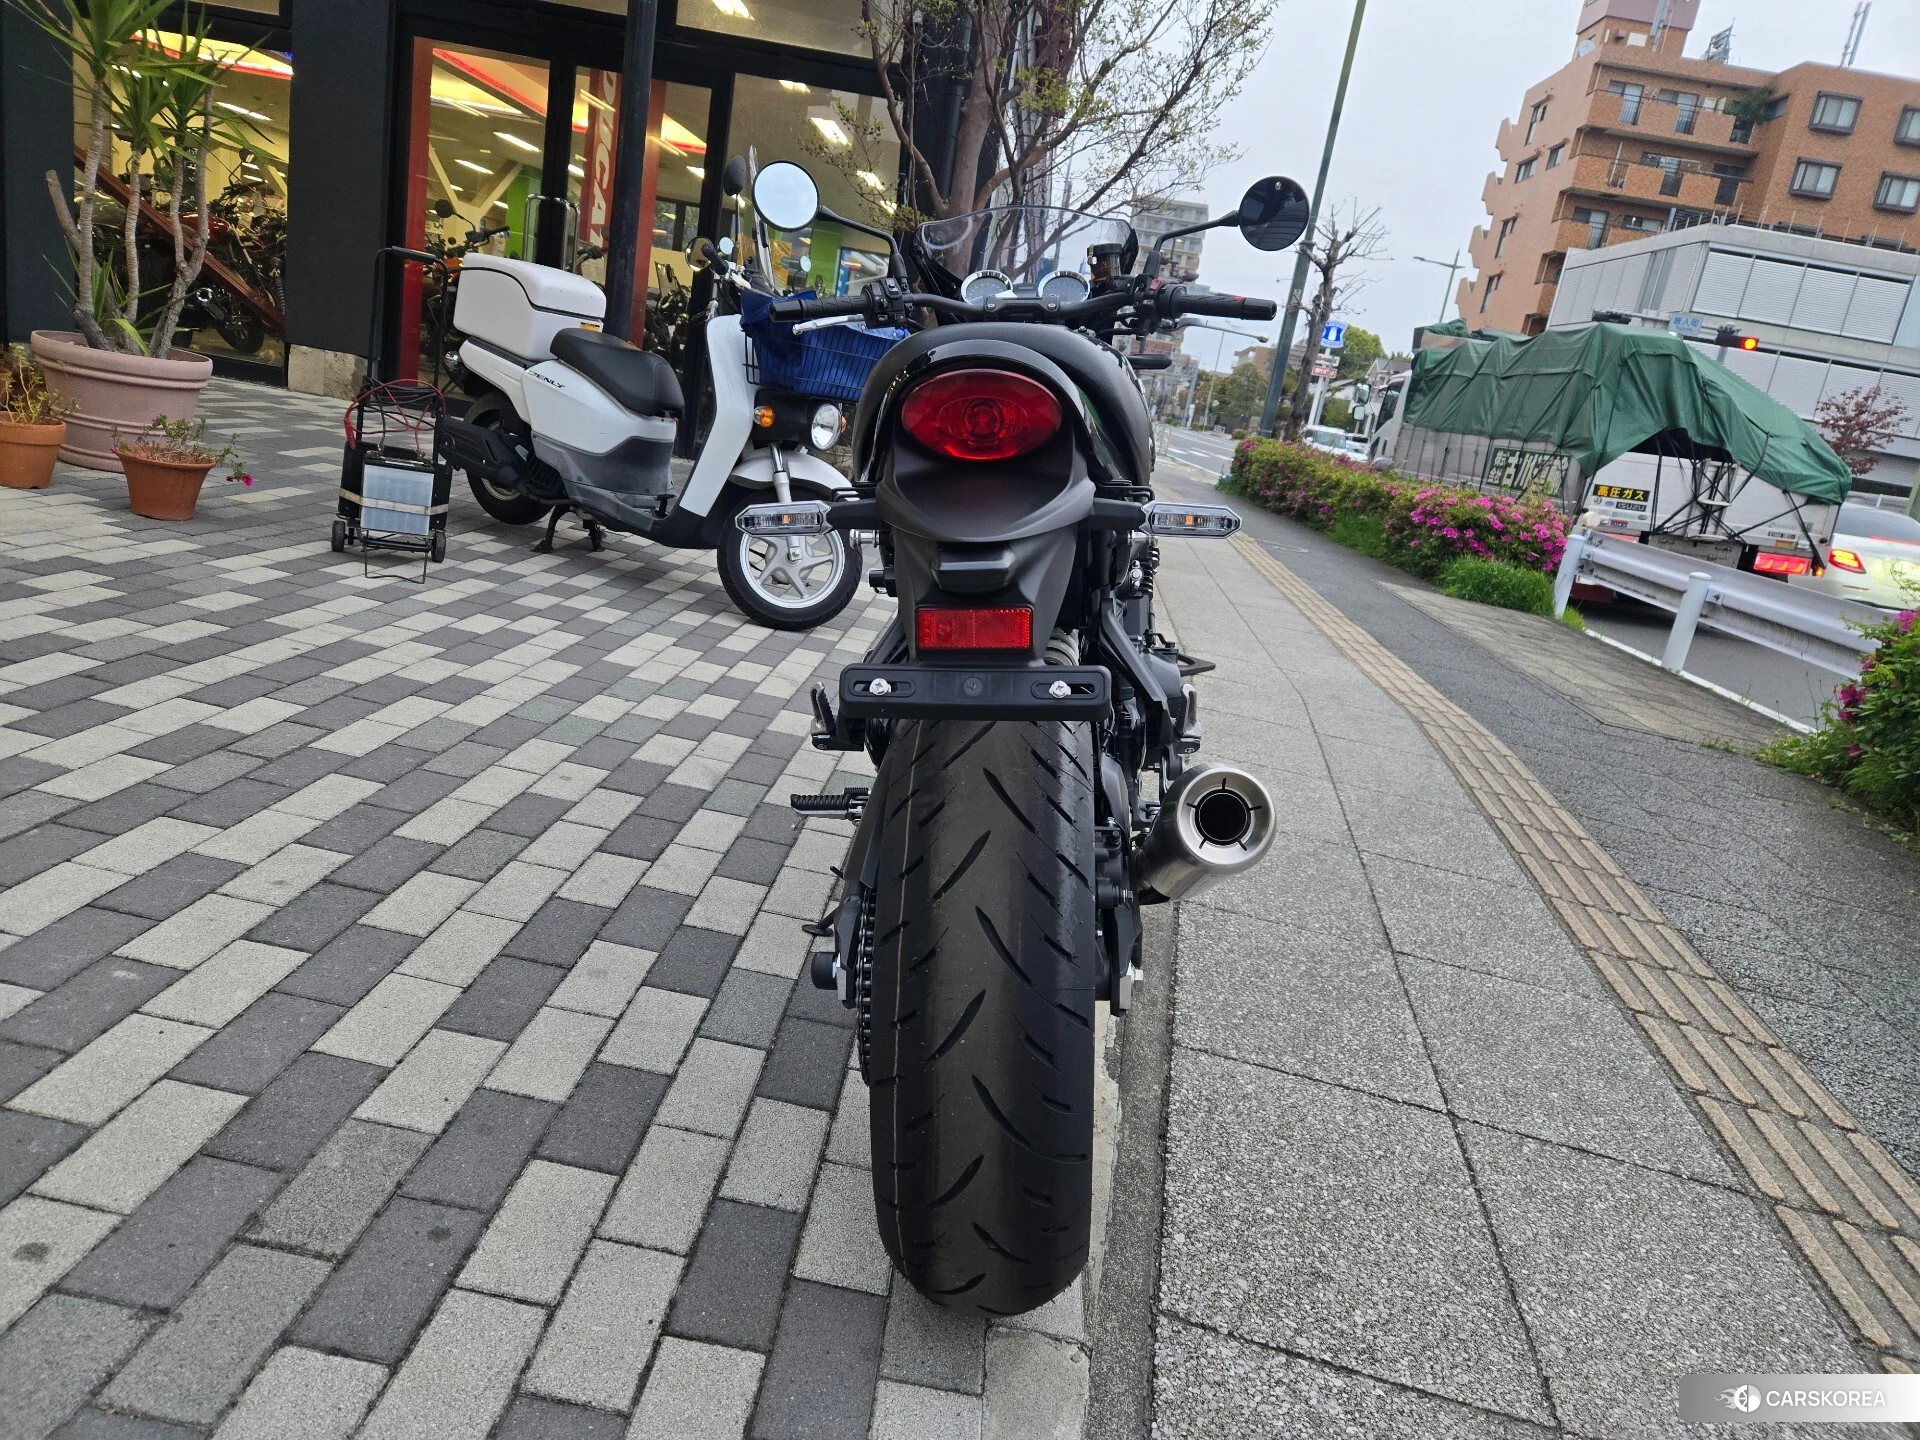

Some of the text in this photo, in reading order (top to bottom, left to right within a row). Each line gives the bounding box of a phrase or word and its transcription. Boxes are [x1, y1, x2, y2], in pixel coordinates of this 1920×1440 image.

[589, 71, 618, 248] DUCAT
[1597, 486, 1645, 501] 高圧ガス
[1618, 502, 1646, 511] ISUZU
